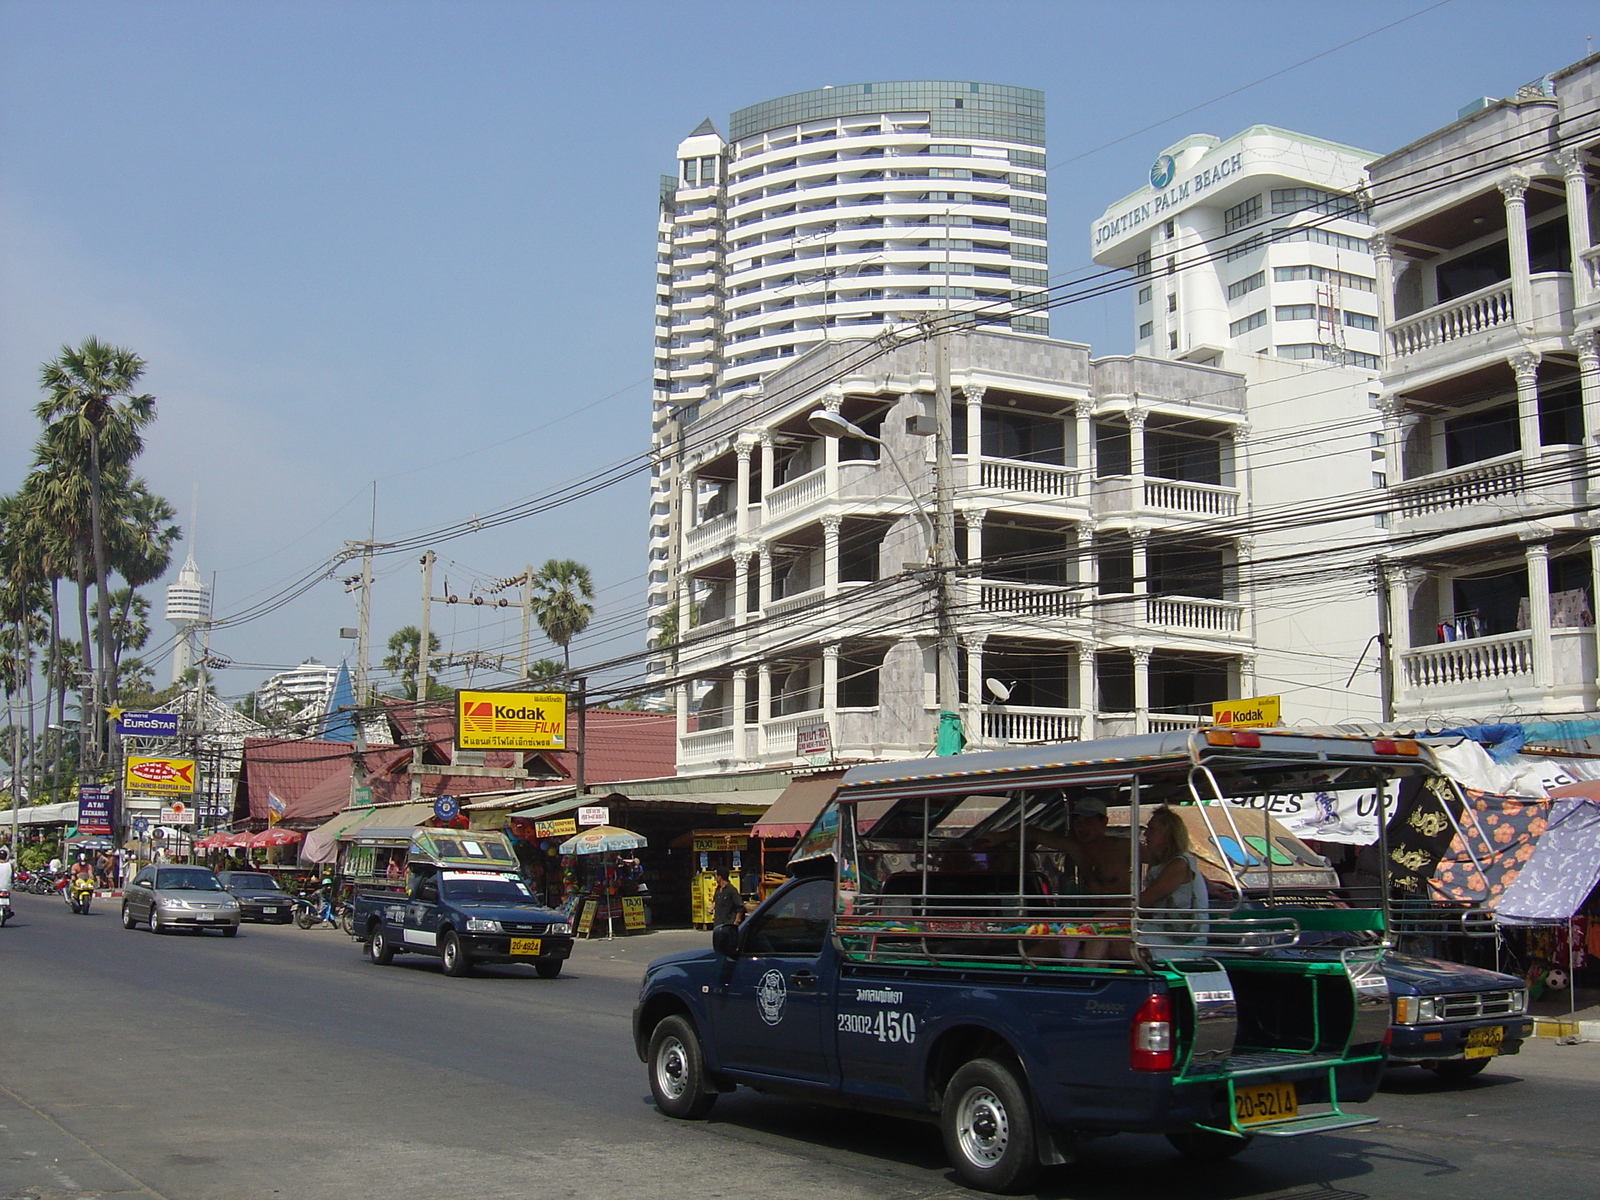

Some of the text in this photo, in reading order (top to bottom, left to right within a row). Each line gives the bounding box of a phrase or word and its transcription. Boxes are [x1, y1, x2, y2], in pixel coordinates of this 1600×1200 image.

[1095, 152, 1242, 244] JOMTIEN PALM BEACH
[495, 705, 546, 720] Kodak
[1233, 709, 1263, 722] Kodak
[534, 721, 560, 733] FILM
[695, 840, 713, 849] TAXI
[624, 898, 642, 907] TAXI
[837, 1010, 916, 1044] 23002 450
[1235, 1088, 1292, 1119] 20-5214
